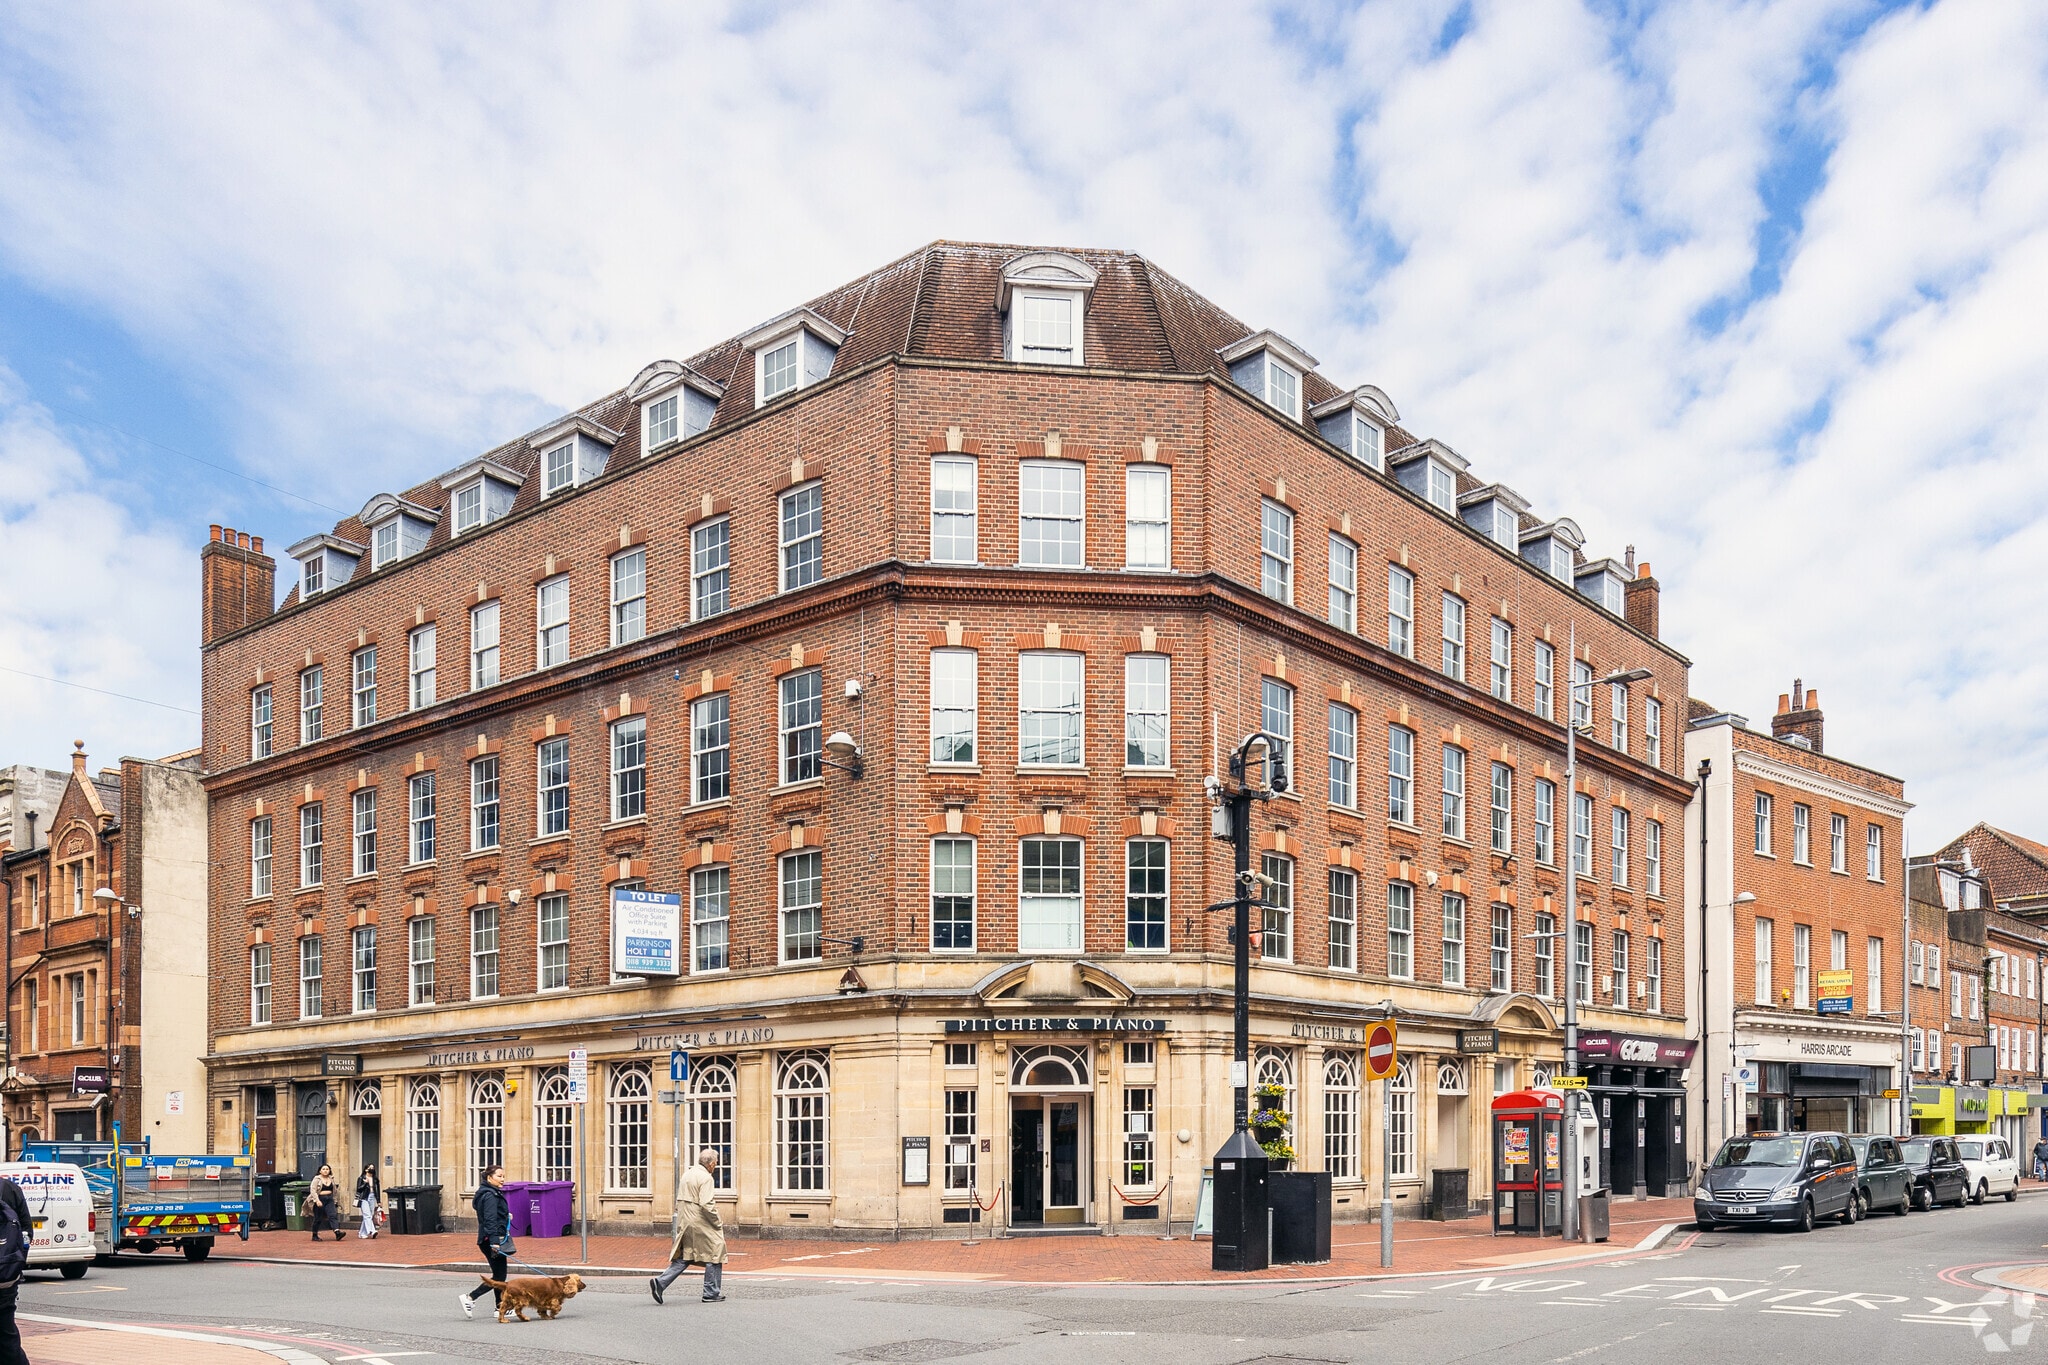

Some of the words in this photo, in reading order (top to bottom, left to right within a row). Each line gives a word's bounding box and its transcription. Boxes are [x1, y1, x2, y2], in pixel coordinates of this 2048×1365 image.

[630, 891, 645, 901] TO
[648, 893, 667, 903] LET
[629, 911, 649, 919] Office
[650, 912, 666, 920] Suite
[634, 905, 674, 914] Conditioned
[644, 919, 668, 928] Parking
[627, 939, 671, 948] PARKINSON
[627, 947, 647, 955] HOLT
[958, 1018, 1051, 1032] PITCHER
[1066, 1017, 1079, 1031] &
[1093, 1018, 1155, 1031] PIANO
[641, 1034, 701, 1050] PITCER
[708, 1031, 717, 1045] &
[725, 1027, 774, 1044] PIANO
[1349, 1028, 1357, 1041] &
[1801, 1043, 1825, 1055] HARRIS
[1826, 1044, 1852, 1056] ARCADE
[432, 1050, 478, 1066] PITCHER
[483, 1049, 491, 1062] &
[496, 1046, 534, 1060] PIANO
[1553, 1079, 1574, 1087] TAXIS
[1430, 1276, 1587, 1292] NO
[1600, 1283, 2010, 1314] ENTRY
